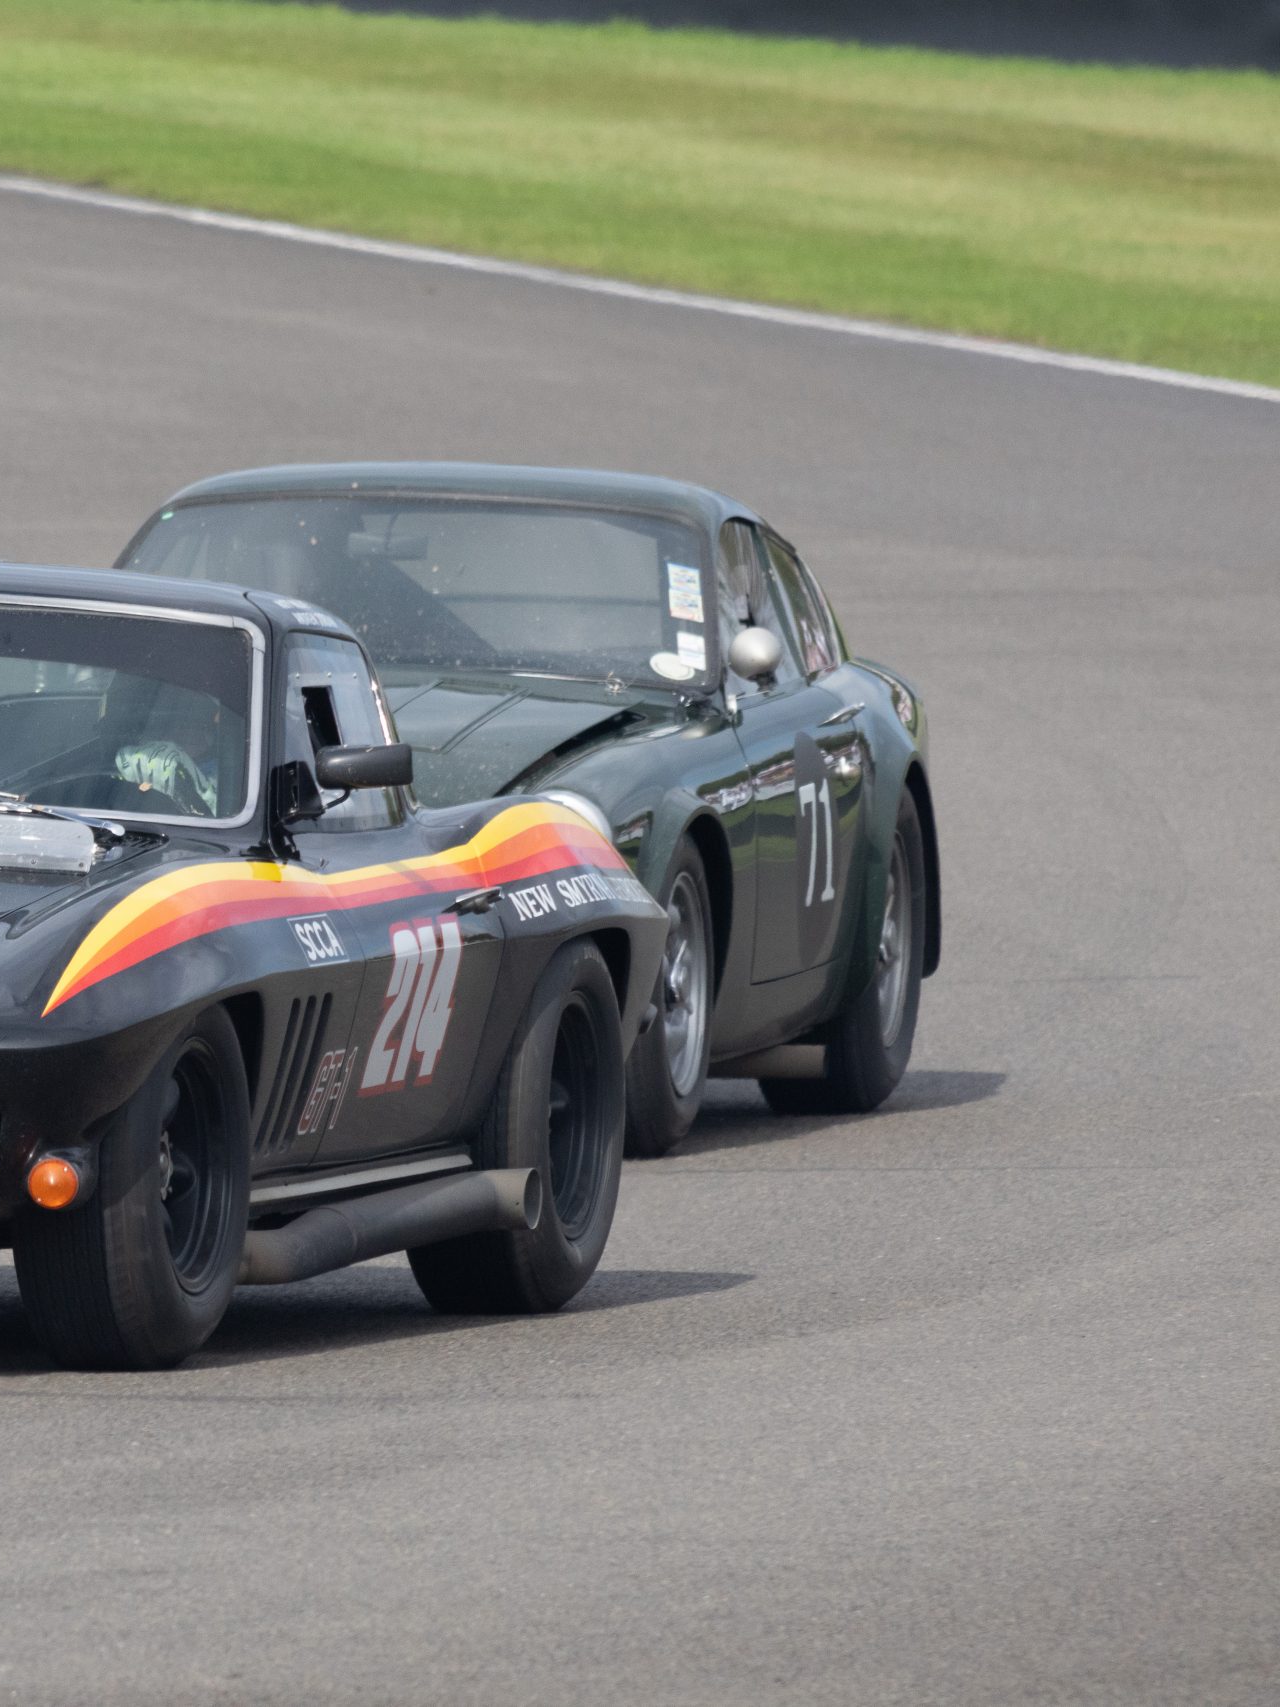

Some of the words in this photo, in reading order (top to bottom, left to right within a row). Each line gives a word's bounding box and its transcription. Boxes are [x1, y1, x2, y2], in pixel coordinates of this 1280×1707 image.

[798, 778, 835, 907] 71
[294, 920, 345, 961] SCCA
[508, 883, 557, 921] NEW
[357, 913, 463, 1098] 214
